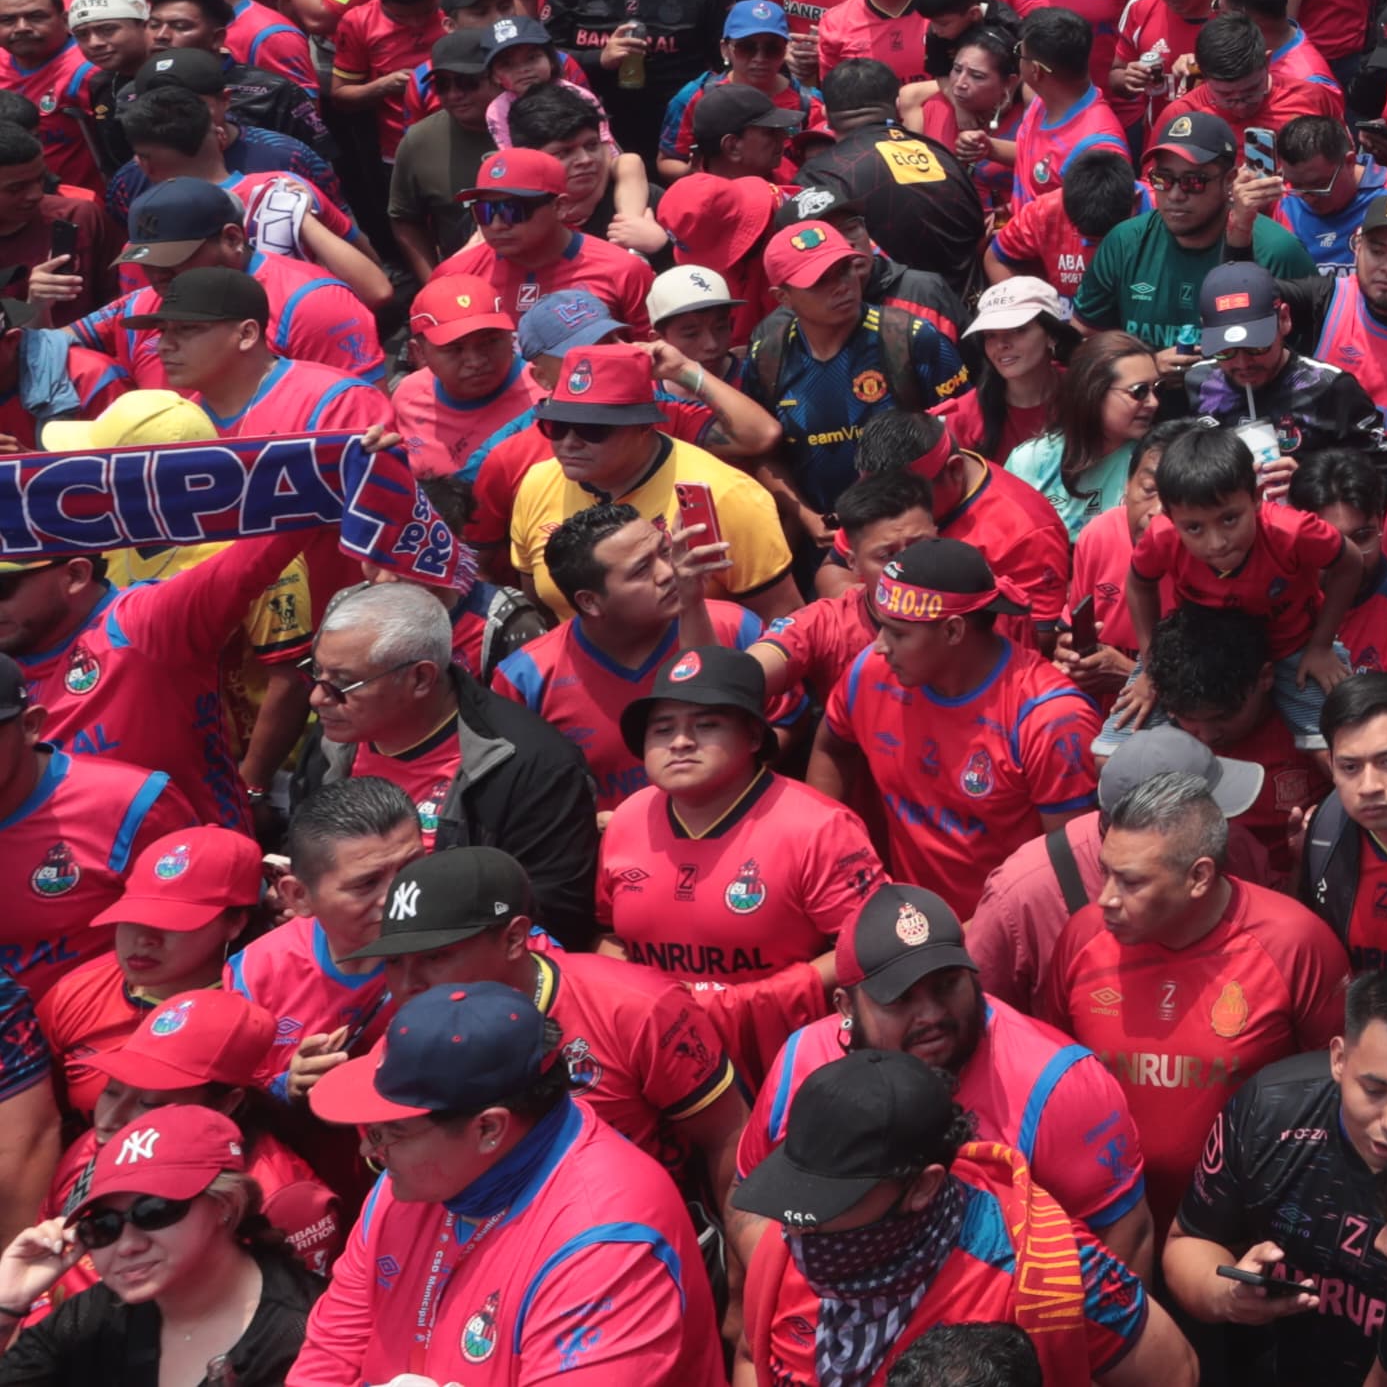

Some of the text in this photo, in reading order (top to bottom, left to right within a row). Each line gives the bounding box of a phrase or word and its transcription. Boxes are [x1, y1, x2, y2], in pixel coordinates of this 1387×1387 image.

[892, 149, 931, 174] tigo
[886, 585, 944, 619] ROJO
[389, 880, 421, 920] NY
[115, 1127, 161, 1165] NY
[1341, 1215, 1369, 1257] Z
[417, 1276, 437, 1326] Municipal
